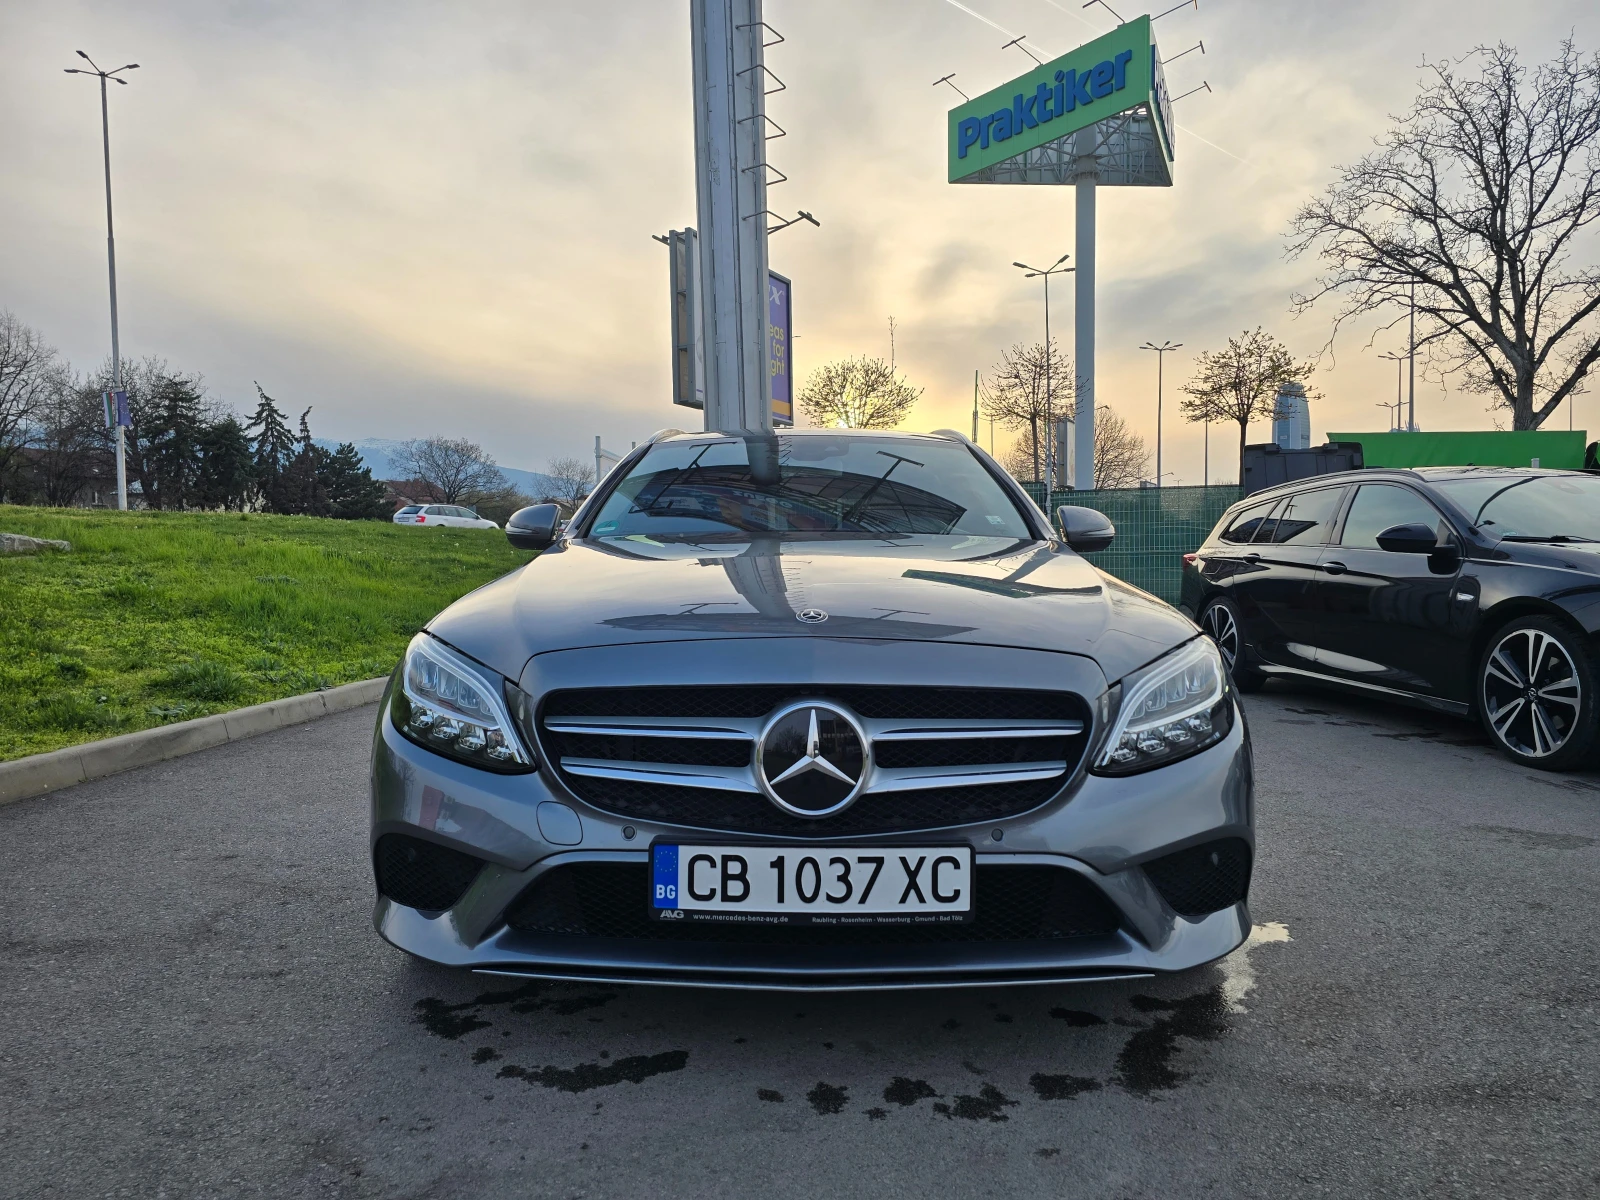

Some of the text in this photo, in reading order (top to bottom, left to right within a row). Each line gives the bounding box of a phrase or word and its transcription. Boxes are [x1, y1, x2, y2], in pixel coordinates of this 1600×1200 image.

[958, 49, 1132, 159] Praktiker
[773, 339, 784, 358] for
[687, 853, 961, 905] CB 1037 XC
[656, 884, 676, 899] BG
[660, 909, 684, 918] AVG
[693, 914, 789, 923] www.mercedes-benz-avg.de
[812, 916, 837, 924] Raubling
[877, 916, 911, 924] Wasserburg
